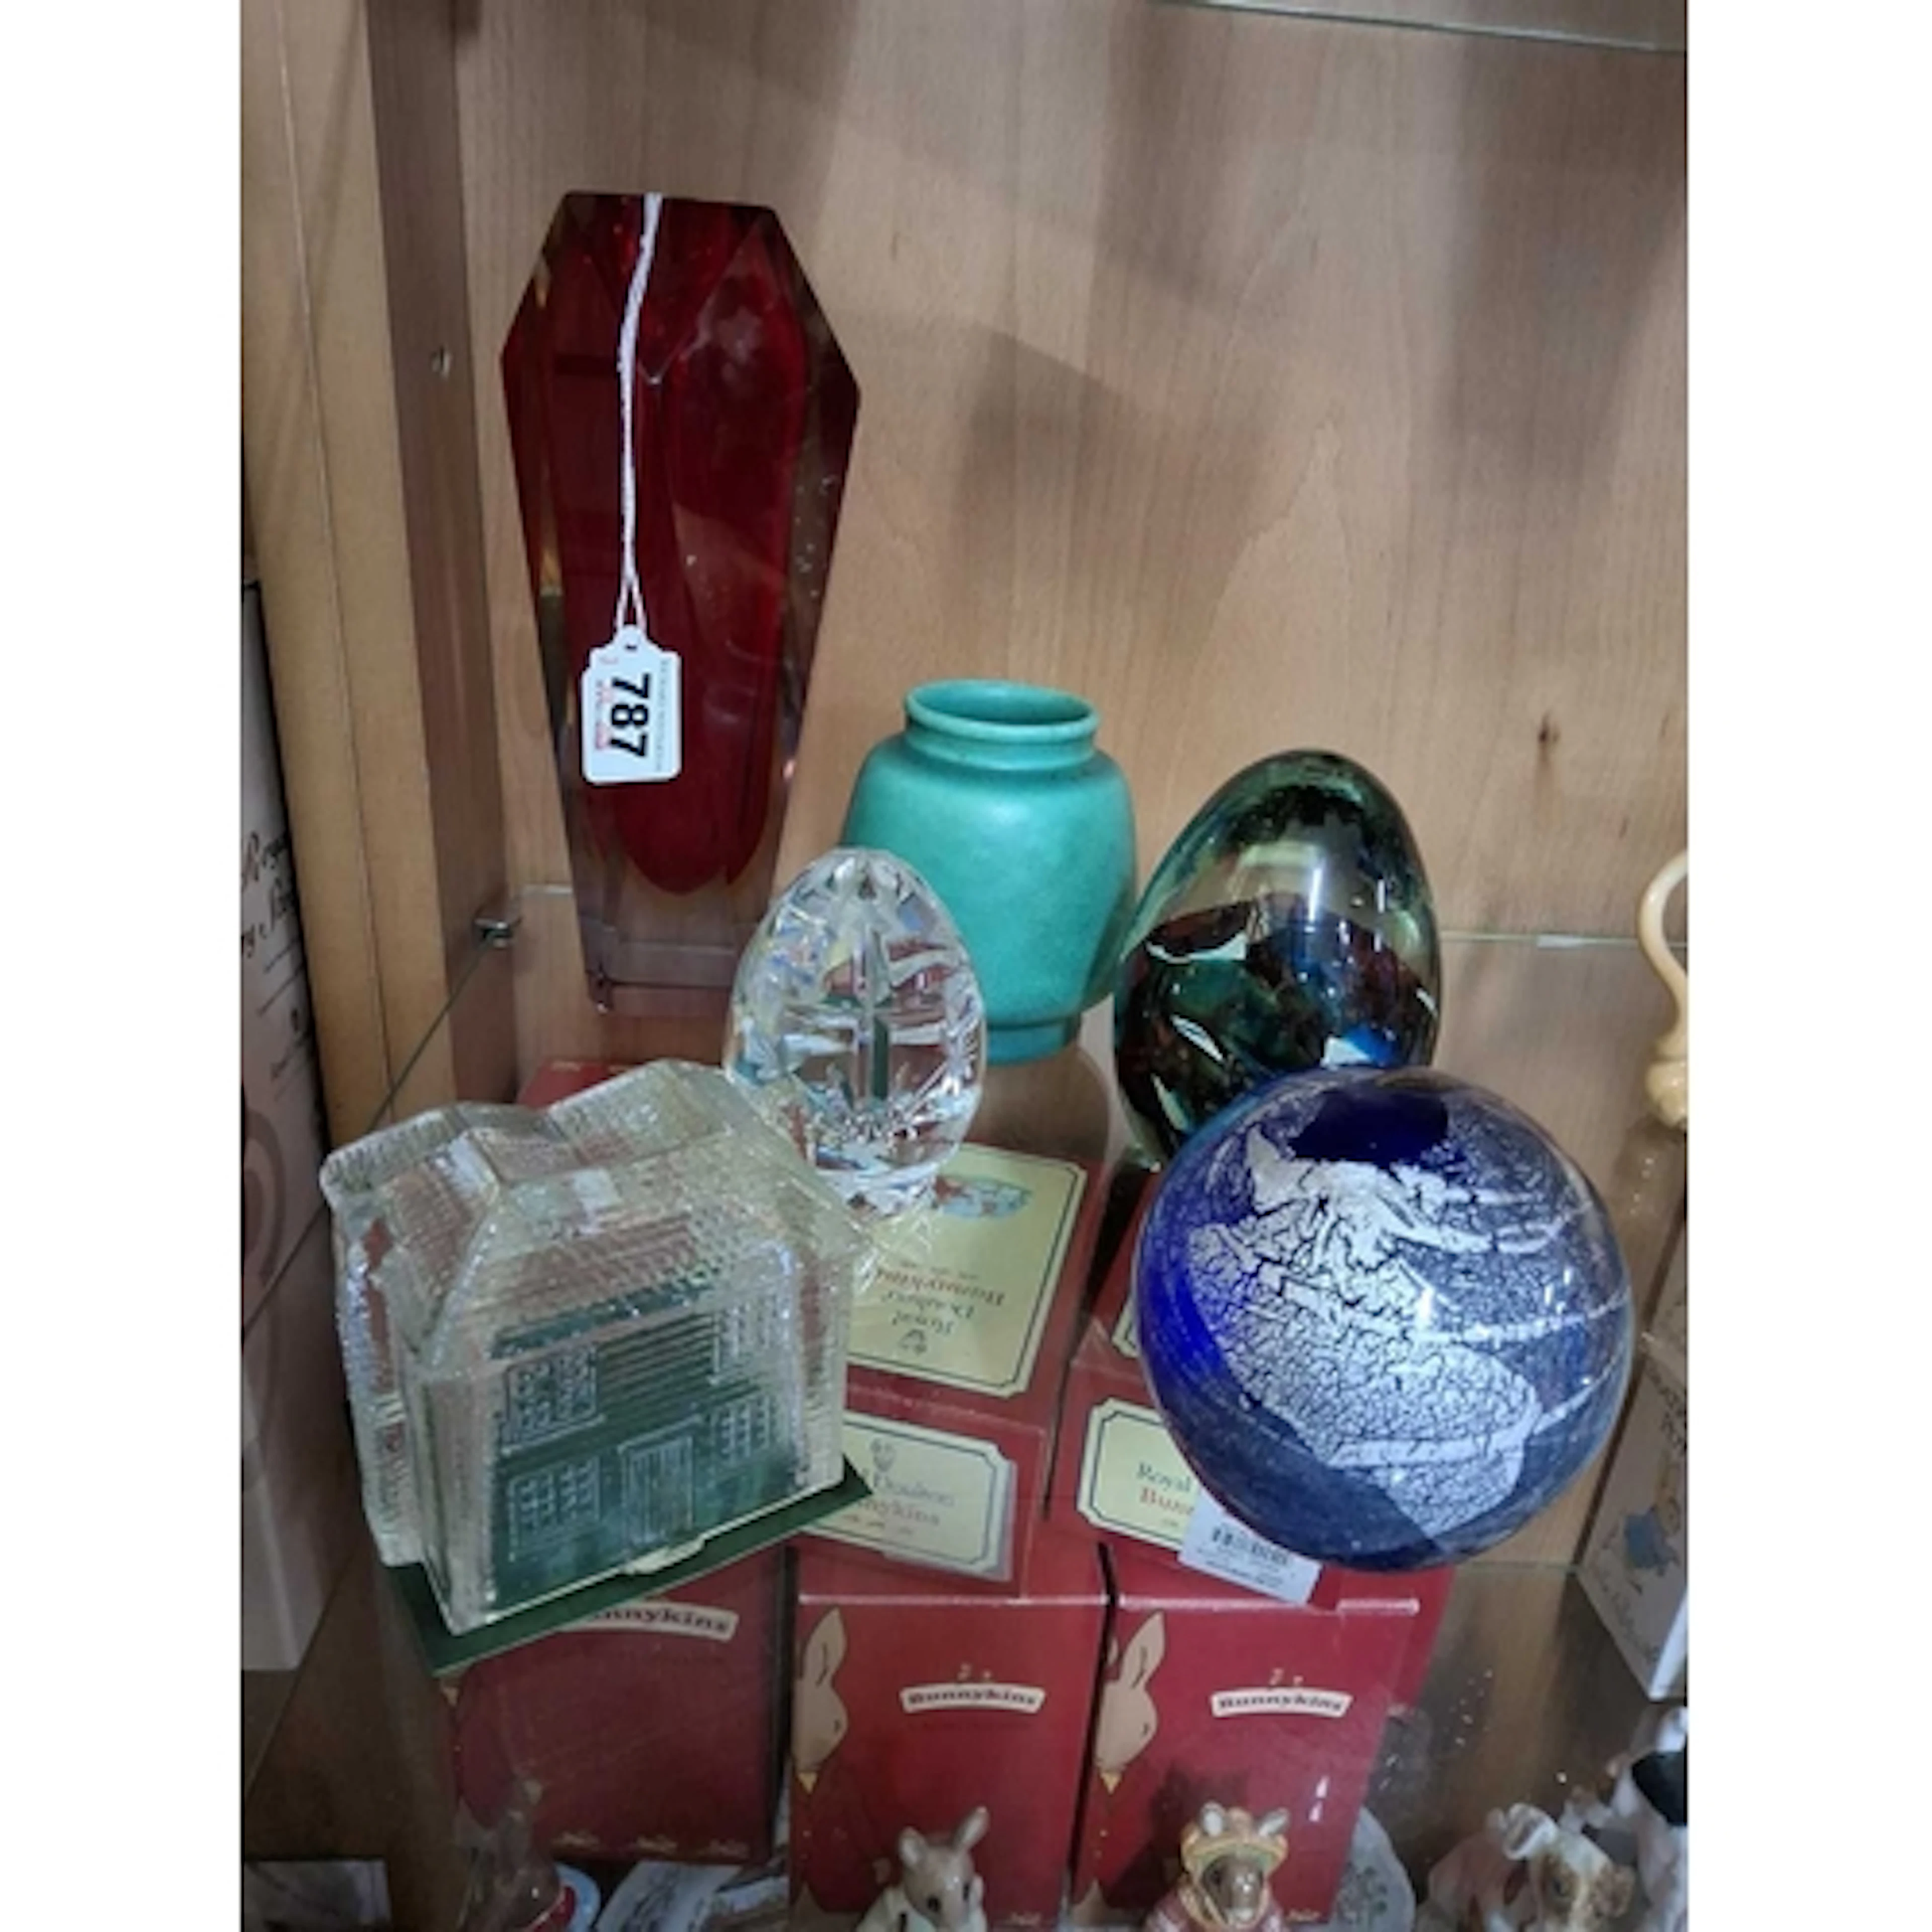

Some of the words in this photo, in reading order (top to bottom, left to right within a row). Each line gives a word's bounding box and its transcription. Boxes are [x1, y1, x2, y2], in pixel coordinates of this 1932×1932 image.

[609, 673, 651, 756] 787
[1136, 1461, 1191, 1493] Royal
[595, 1608, 728, 1632] nnykins
[908, 1688, 1036, 1705] Bunnykins
[1219, 1693, 1342, 1711] Bunnykins
